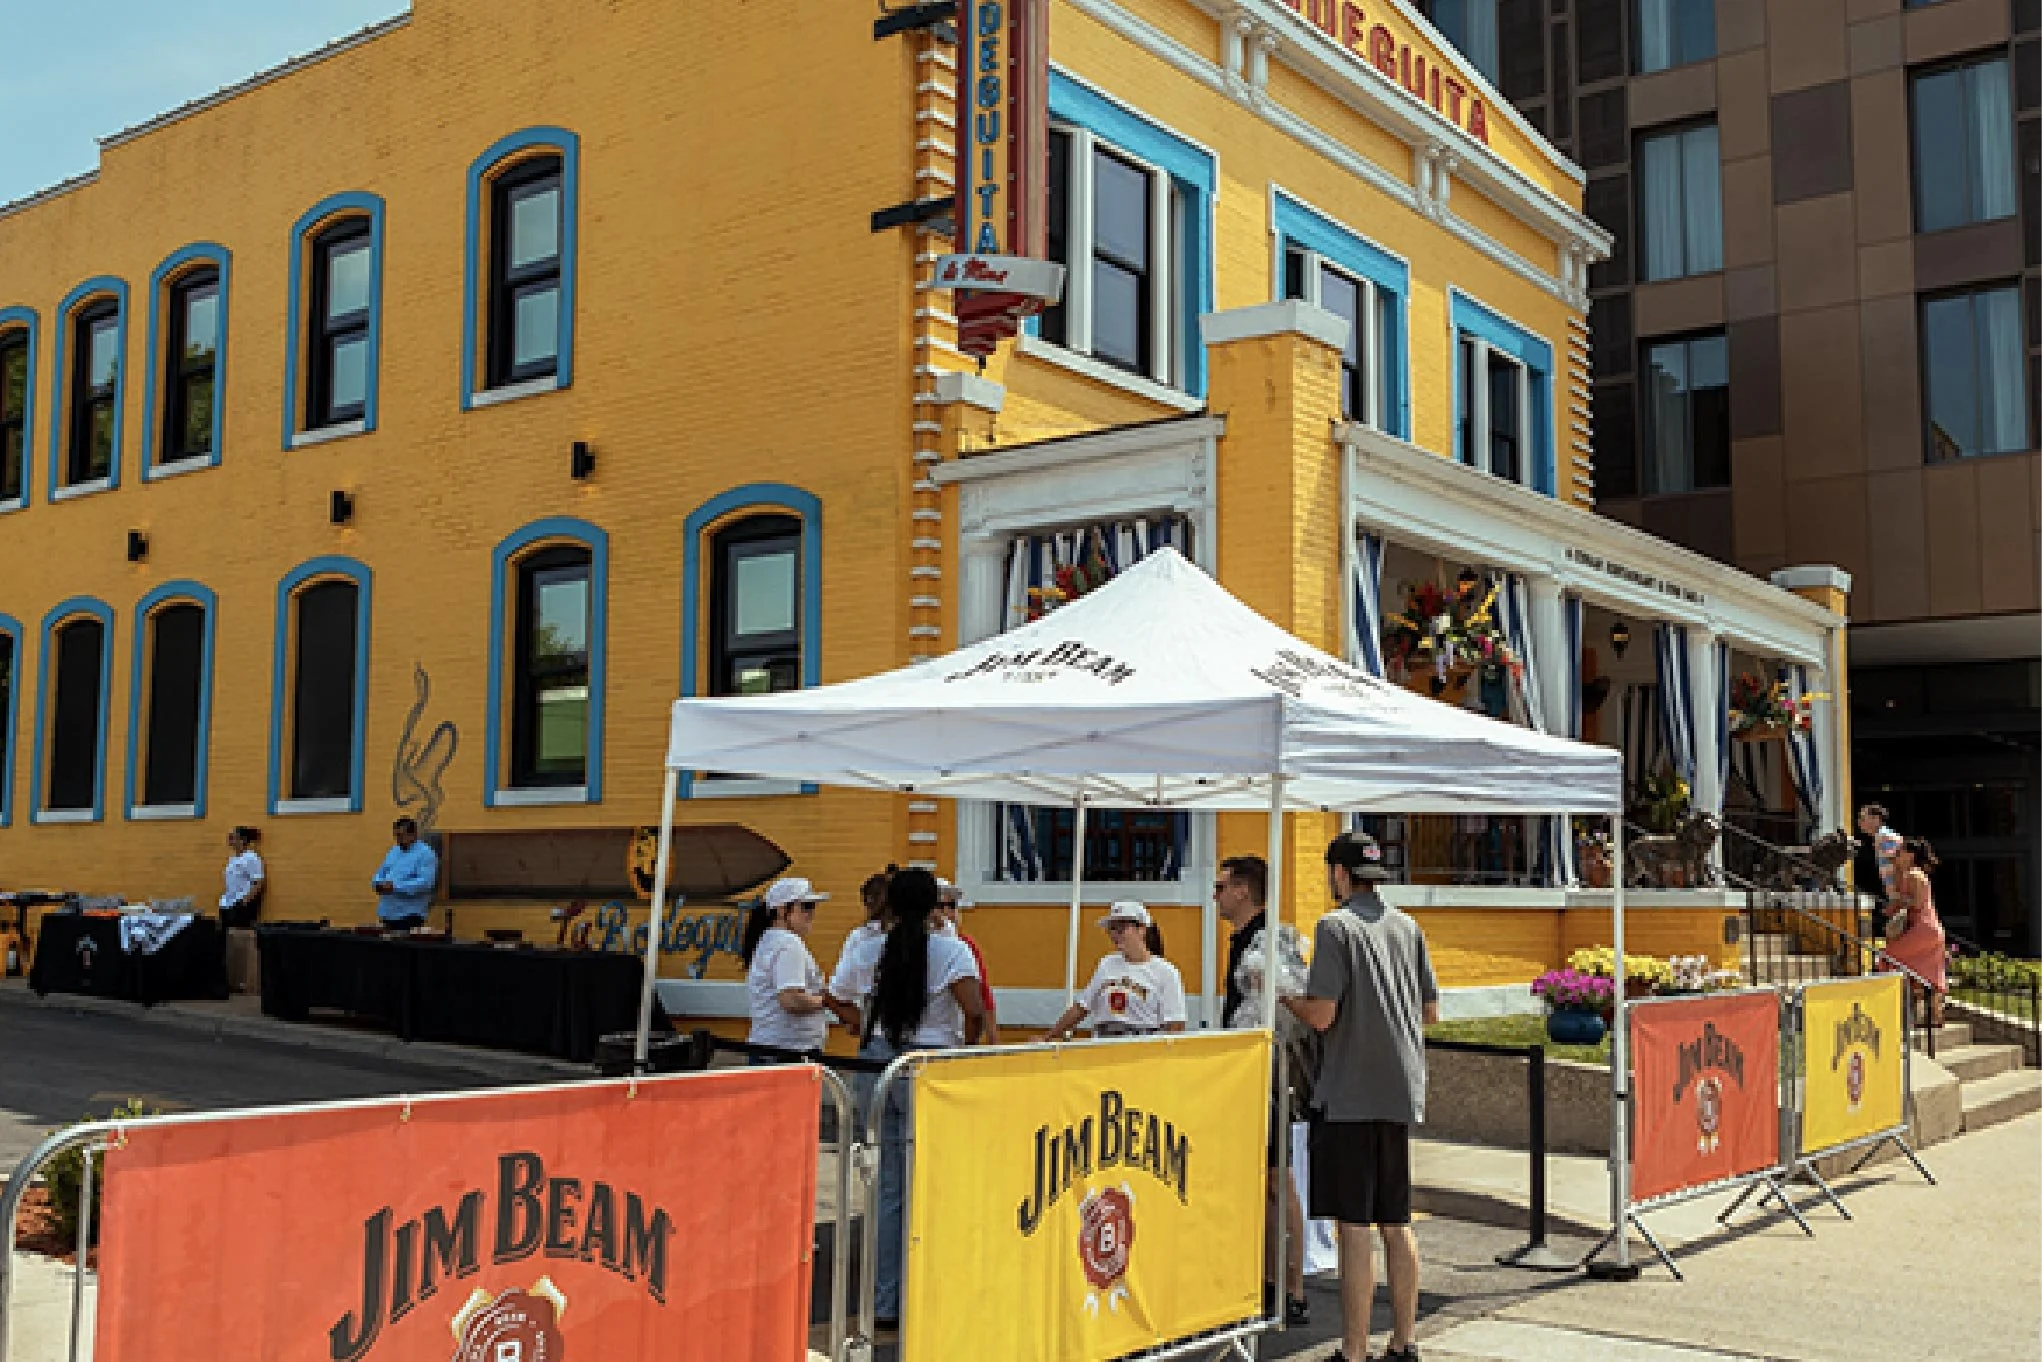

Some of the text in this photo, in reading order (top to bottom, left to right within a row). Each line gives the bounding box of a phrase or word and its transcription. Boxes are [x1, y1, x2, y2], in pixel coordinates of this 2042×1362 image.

[1017, 1089, 1189, 1237] JIM BEAM
[328, 1150, 672, 1362] JIM BEAM
